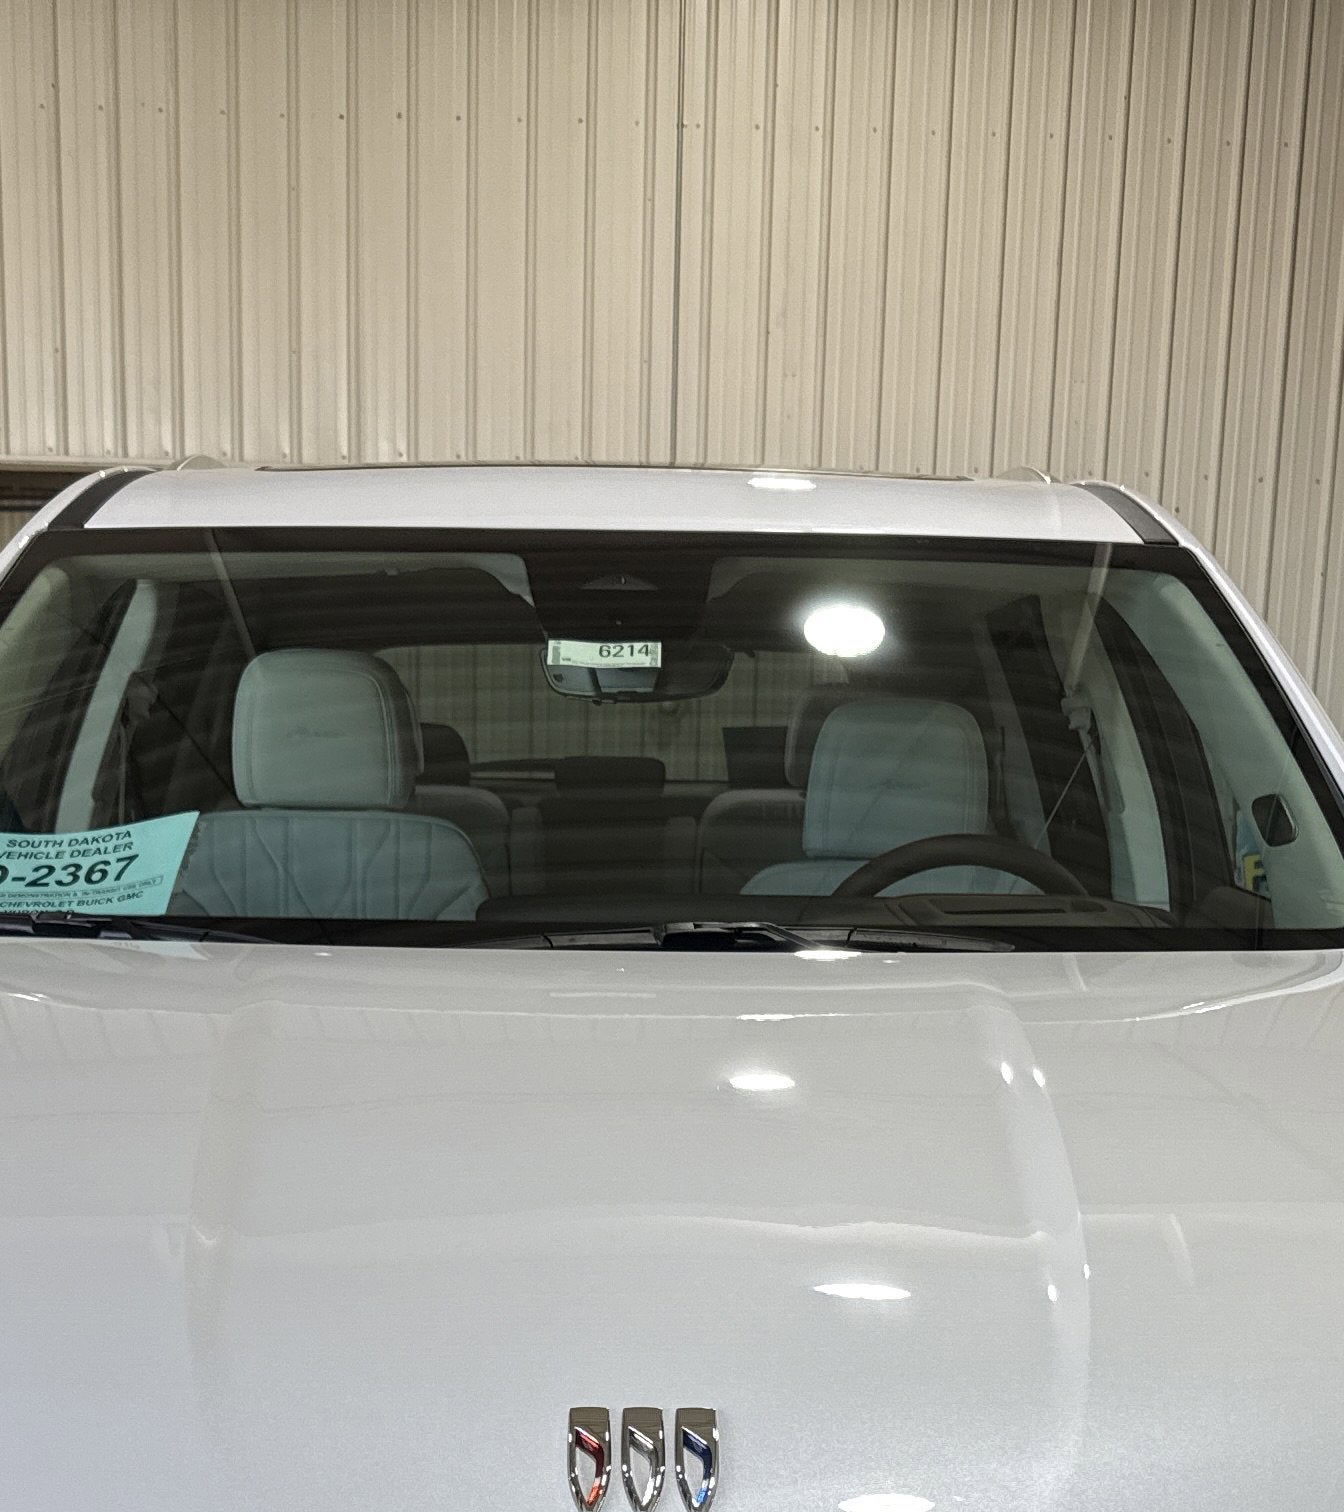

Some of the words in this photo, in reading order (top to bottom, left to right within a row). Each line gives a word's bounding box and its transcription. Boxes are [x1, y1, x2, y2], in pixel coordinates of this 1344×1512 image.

[598, 644, 649, 658] 6214
[6, 838, 64, 849] SOUTH
[67, 830, 132, 848] DAKOTA
[69, 841, 134, 859] DEALER
[0, 900, 75, 908] CHEVROLET
[76, 897, 114, 907] BUICK
[117, 890, 144, 902] GMC
